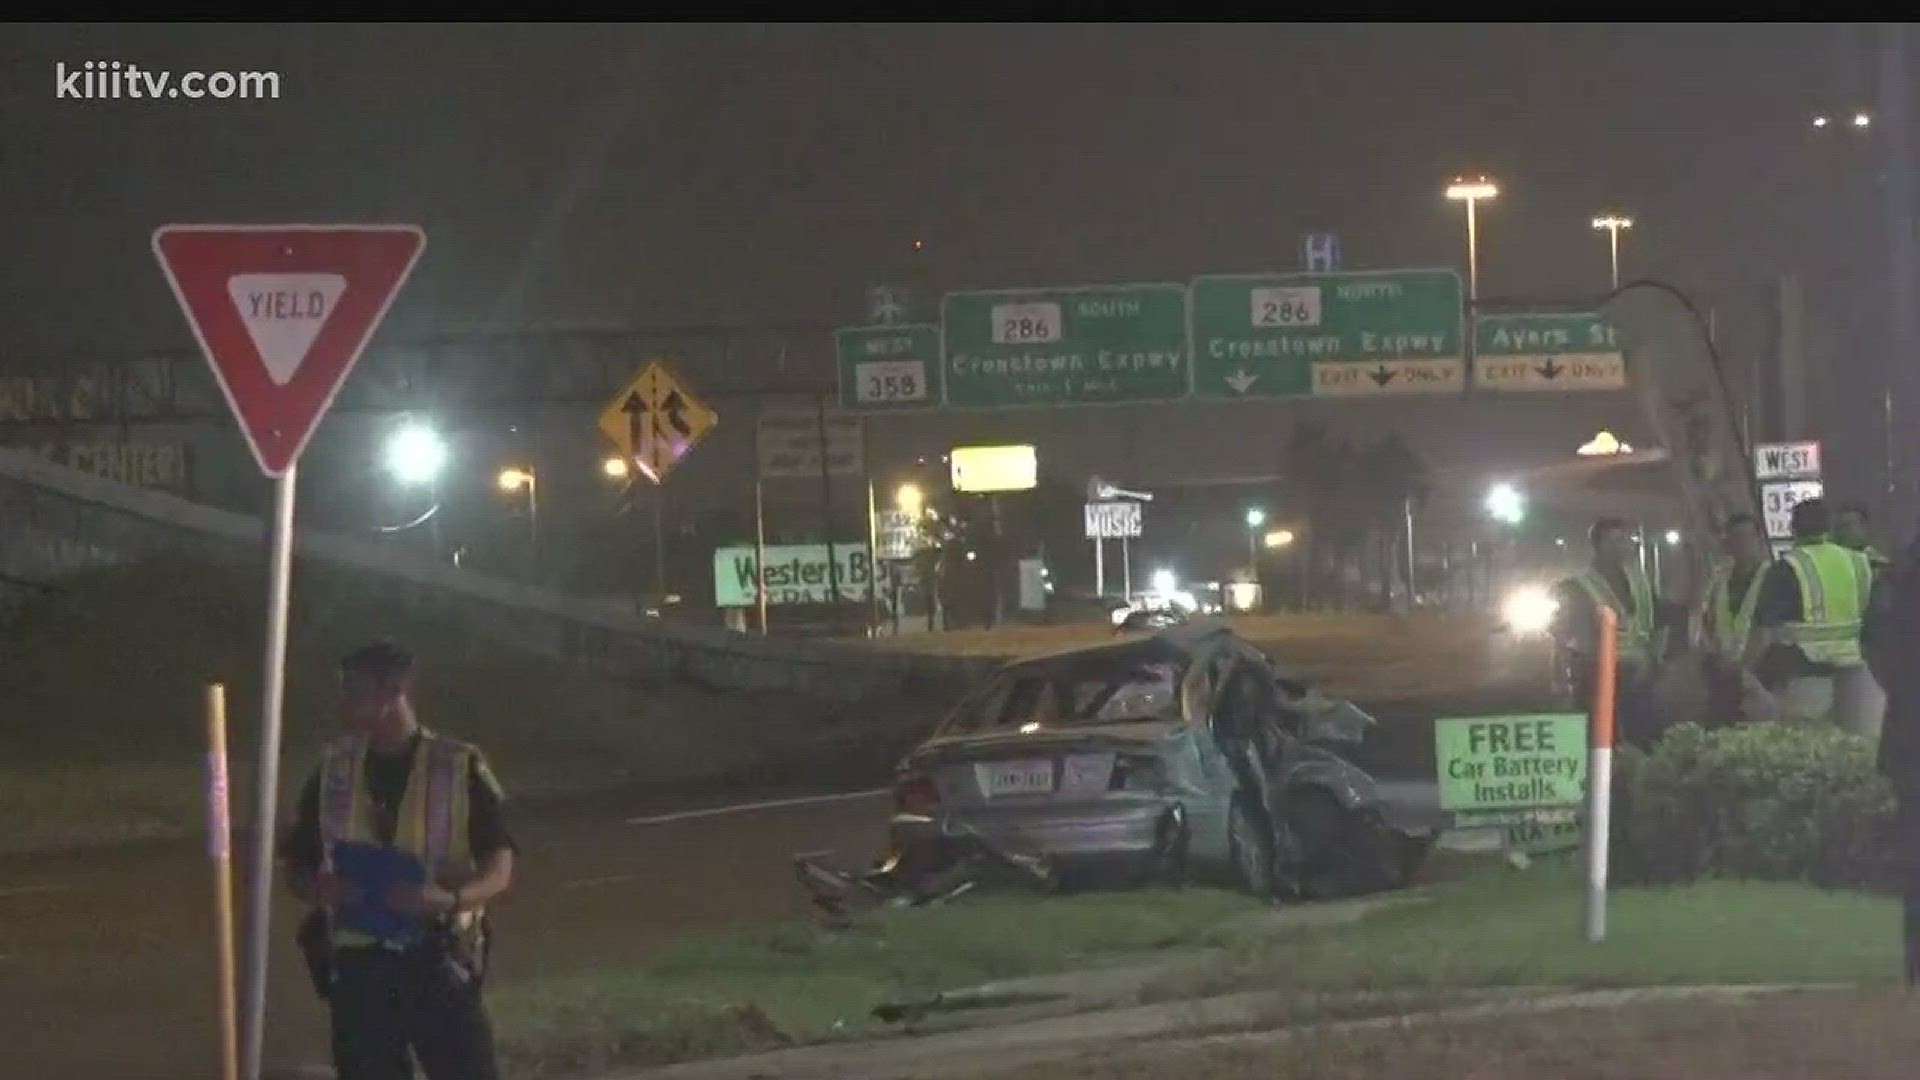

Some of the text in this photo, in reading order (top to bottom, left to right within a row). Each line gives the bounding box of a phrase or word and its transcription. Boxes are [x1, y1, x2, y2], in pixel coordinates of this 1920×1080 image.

[248, 291, 324, 319] YIELD
[1076, 300, 1140, 316] SOUTH
[1262, 302, 1309, 323] 286
[1004, 318, 1050, 341] 286
[1361, 332, 1446, 355] Expwy
[1098, 350, 1181, 372] Expwy
[1486, 363, 1528, 380] EXIT
[869, 375, 916, 399] 358
[1765, 450, 1809, 470] WEST
[1086, 508, 1141, 537] MUSIC
[733, 554, 845, 591] Western
[1468, 720, 1556, 754] FREE
[1448, 756, 1579, 781] Car Battery
[1474, 778, 1557, 803] Installs
